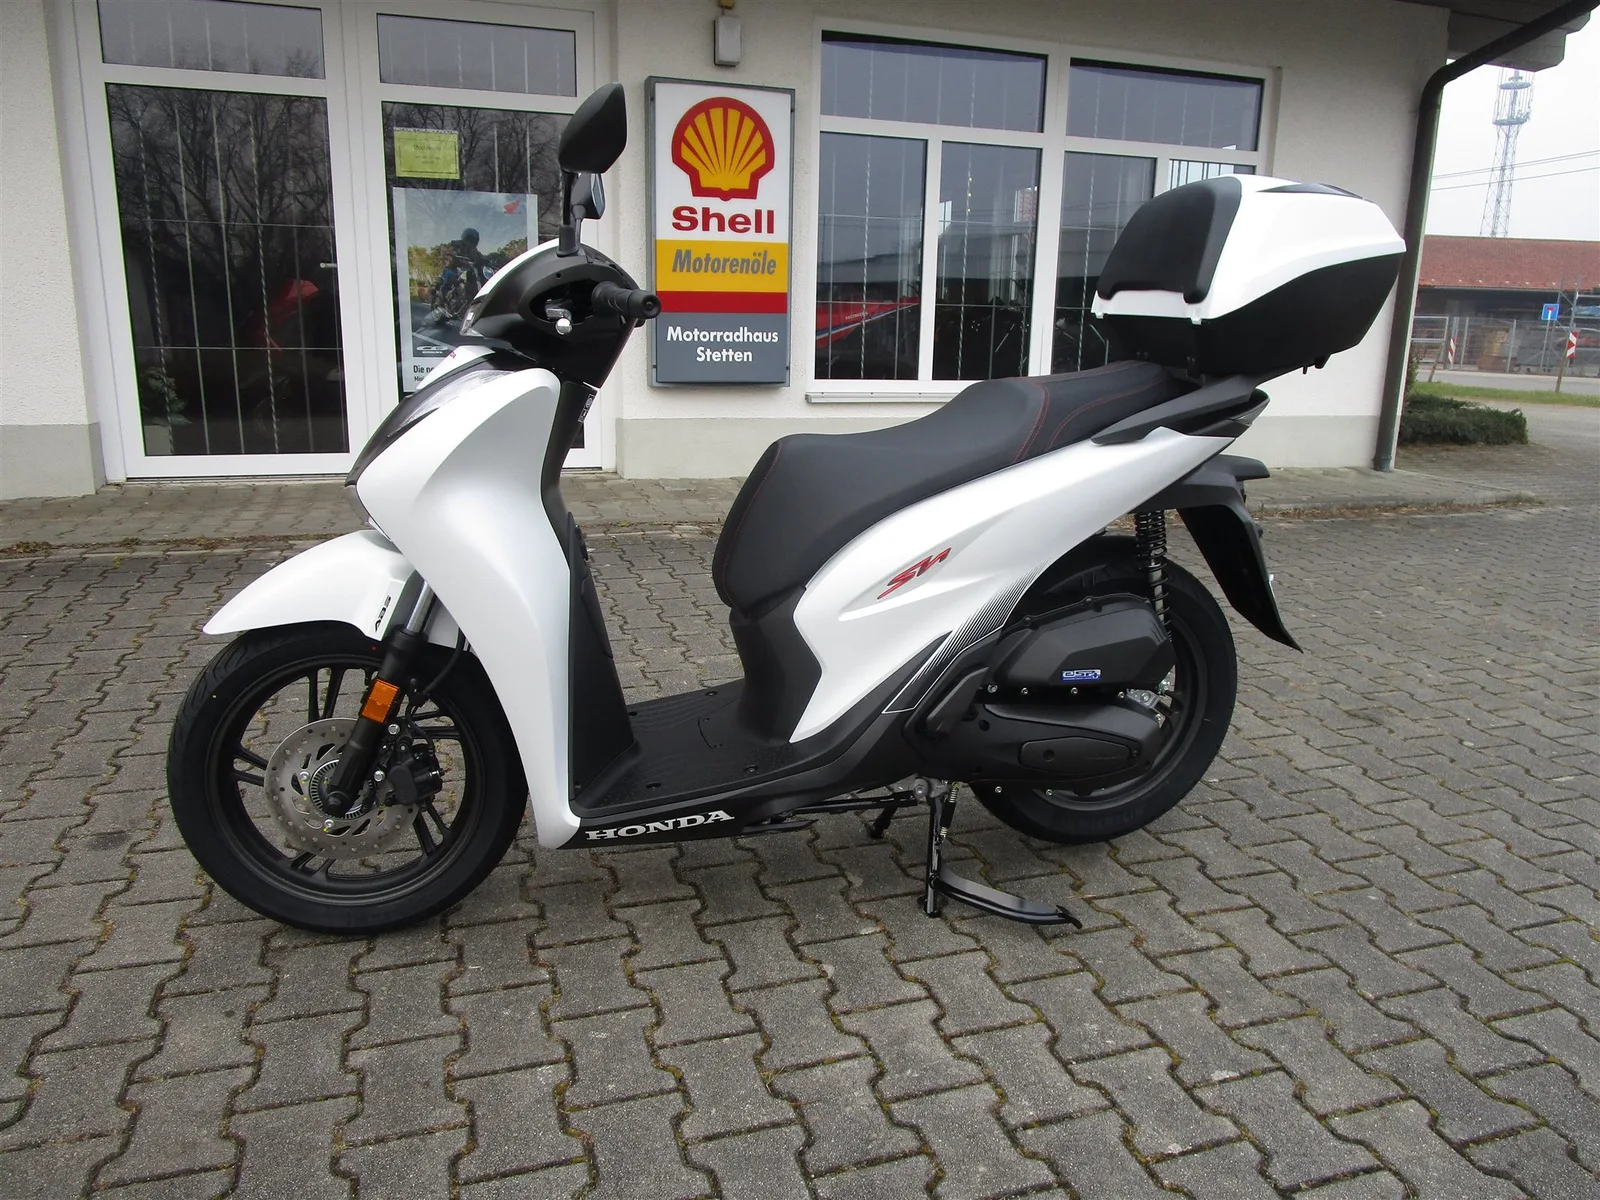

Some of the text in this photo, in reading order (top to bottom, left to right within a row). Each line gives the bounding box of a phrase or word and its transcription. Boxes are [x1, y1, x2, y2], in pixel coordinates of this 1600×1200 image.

[672, 206, 774, 234] Shell
[672, 249, 776, 274] Motorenöle
[666, 326, 779, 342] Motorradhaus
[696, 346, 753, 362] Stetten
[413, 365, 425, 374] Die
[374, 595, 391, 632] ABS
[585, 810, 735, 840] HONDA
